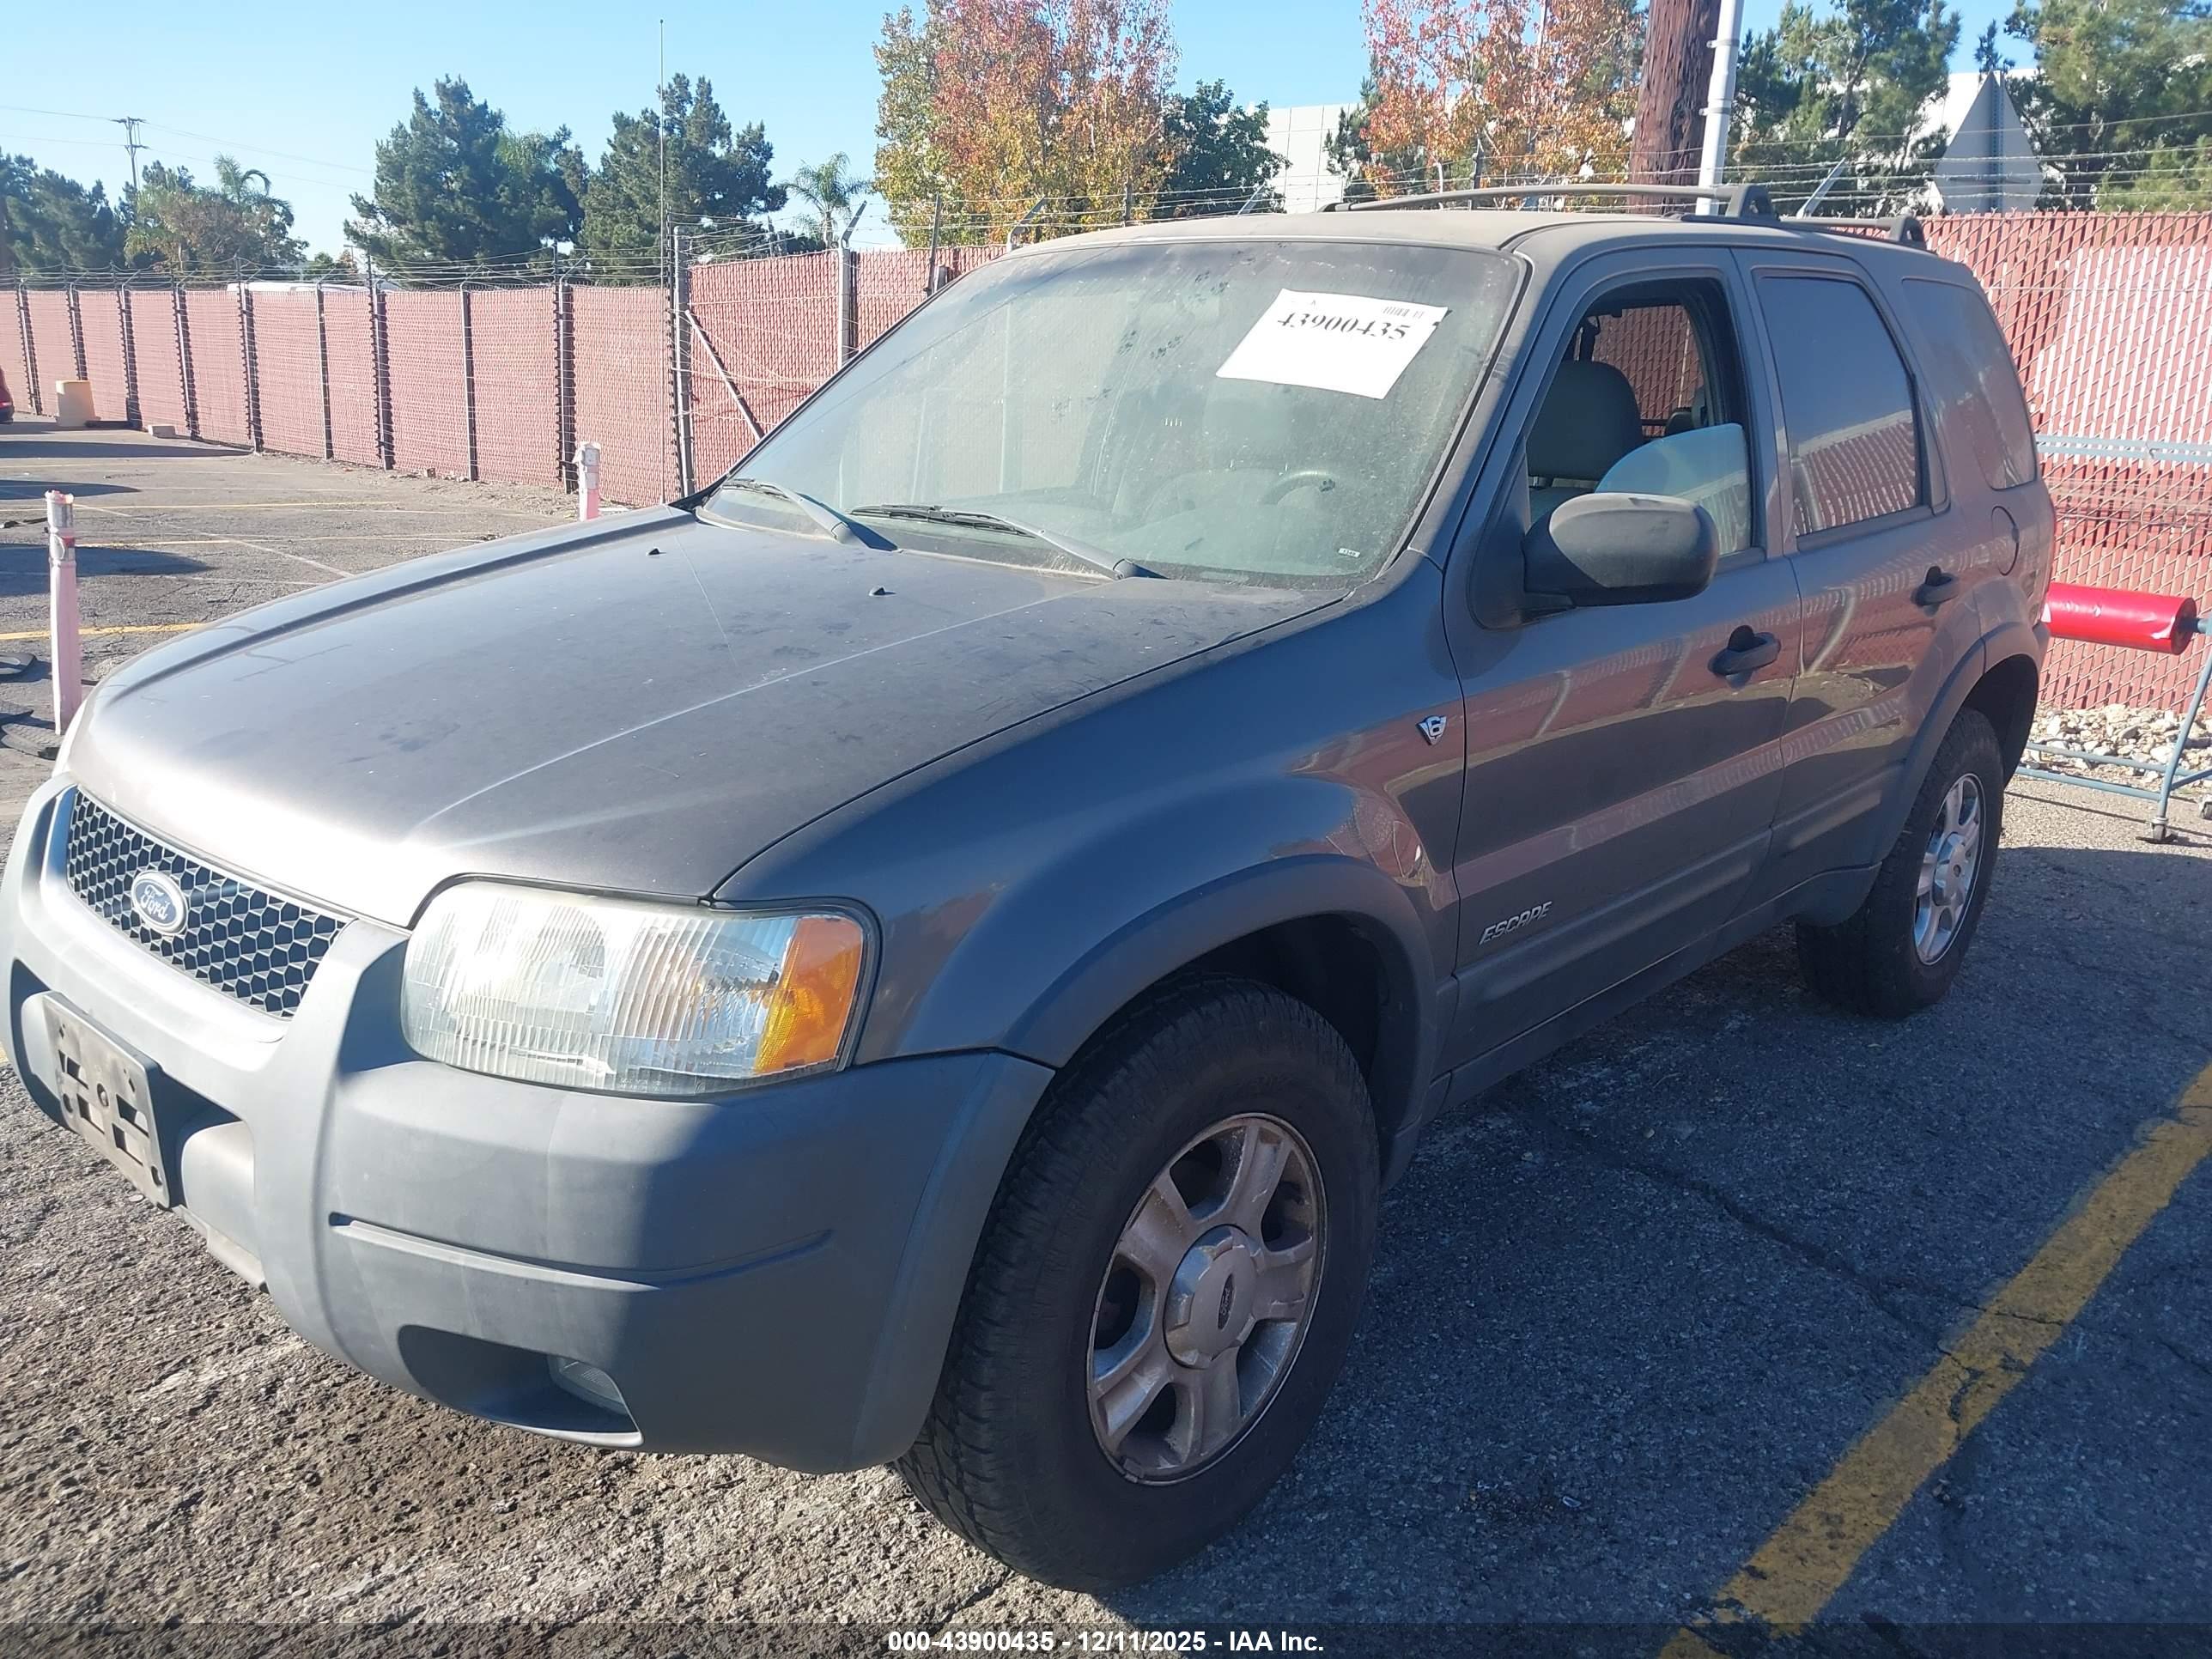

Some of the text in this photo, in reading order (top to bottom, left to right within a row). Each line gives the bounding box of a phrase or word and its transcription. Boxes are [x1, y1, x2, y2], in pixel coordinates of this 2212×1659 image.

[1278, 312, 1410, 340] 43900435
[140, 884, 171, 920] Ford
[1479, 901, 1553, 945] ESCAPE
[1220, 1287, 1231, 1316] Ford
